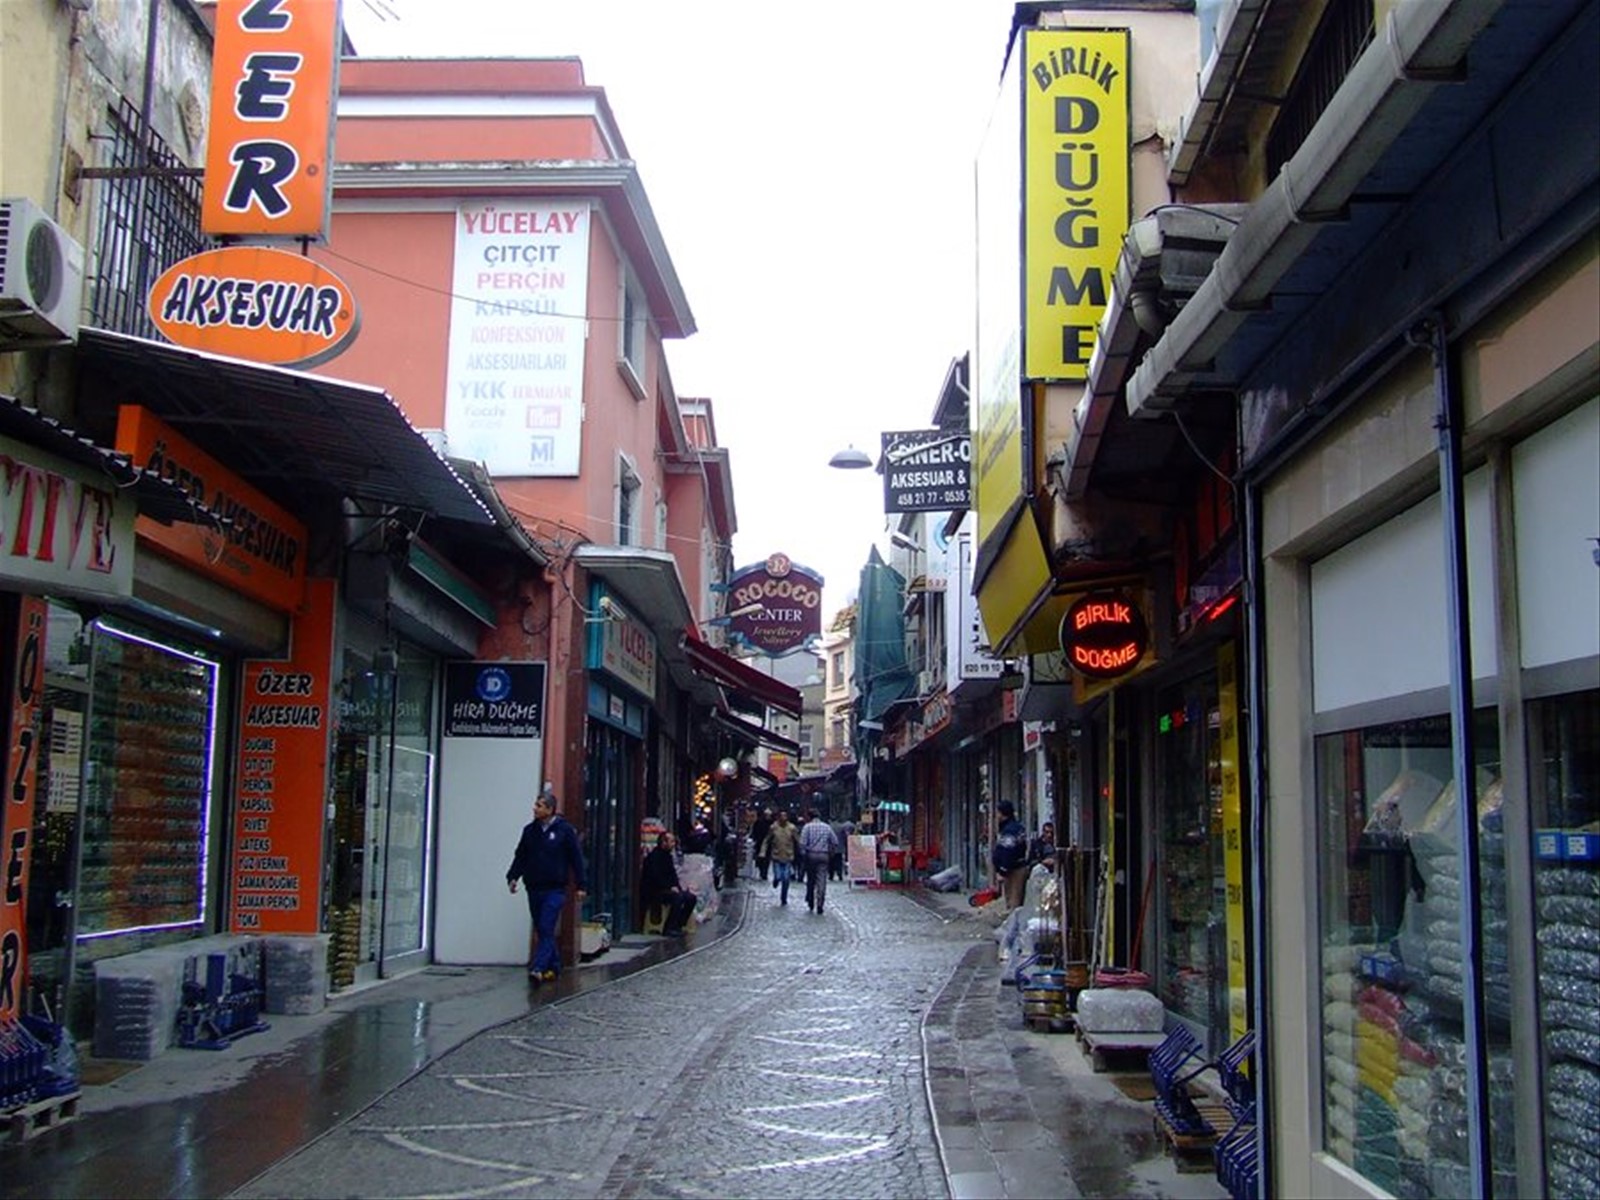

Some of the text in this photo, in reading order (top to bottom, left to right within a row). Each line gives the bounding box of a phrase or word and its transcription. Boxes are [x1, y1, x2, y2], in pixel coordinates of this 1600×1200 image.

[463, 207, 579, 234] YÜCELAY
[1047, 96, 1107, 365] DÜĞME
[484, 245, 561, 267] ÇITÇIT
[477, 266, 565, 293] PERÇİN
[162, 275, 341, 337] AKSESUAR
[459, 381, 506, 399] YKK
[891, 469, 967, 488] AKSESUAR &
[735, 579, 819, 608] ROCOCO
[1076, 603, 1130, 630] BİRLİK
[1075, 643, 1137, 668] DÜĞME
[257, 667, 313, 697] ÖZER
[246, 704, 322, 728] AKSESUAR
[453, 700, 537, 721] HİRA DÜĞME
